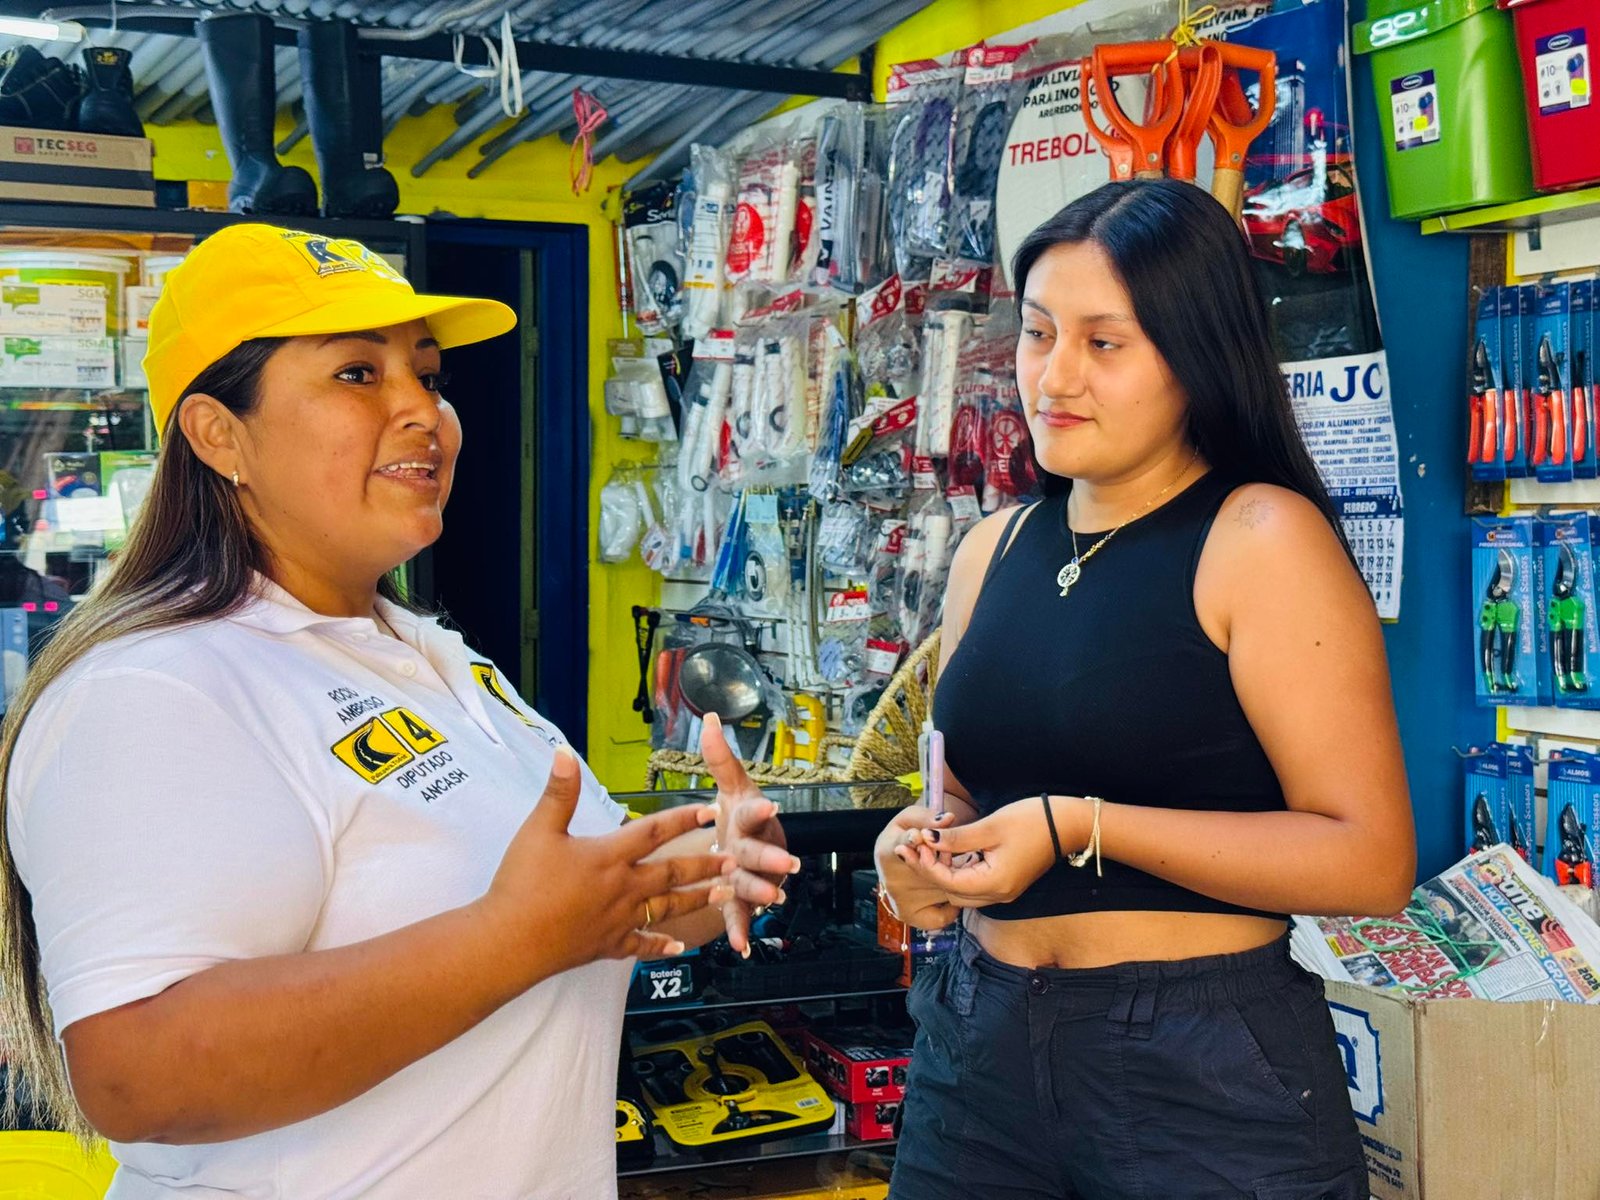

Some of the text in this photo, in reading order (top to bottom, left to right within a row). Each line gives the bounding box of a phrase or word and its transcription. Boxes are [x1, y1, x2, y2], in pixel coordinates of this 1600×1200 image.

[1023, 90, 1052, 108] PARA
[37, 138, 98, 153] TECSEG
[1009, 132, 1096, 166] TREBOL
[820, 150, 837, 231] VAINSA
[1284, 362, 1383, 402] RIA JC
[1327, 417, 1364, 428] ALUMINIO
[1344, 502, 1378, 513] FEBRERO
[1359, 521, 1364, 531] 4
[1367, 520, 1373, 531] 5
[1377, 520, 1383, 531] 6
[1389, 520, 1395, 531] 7
[1367, 538, 1374, 549] 12
[1376, 538, 1384, 549] 13
[1387, 538, 1395, 549] 14
[1367, 556, 1374, 567] 19
[1537, 555, 1545, 593] Scissors
[1582, 551, 1591, 591] Scissors
[1376, 572, 1383, 583] 27
[1385, 572, 1392, 583] 28
[1520, 555, 1531, 654] Multi-Purpose Scissors
[397, 710, 438, 743] 4
[396, 750, 453, 790] DIPUTADO
[1566, 769, 1591, 778] ALMOS
[420, 768, 469, 803] ANCASH
[1591, 793, 1600, 831] Scissors
[1482, 885, 1507, 911] HOY
[1501, 904, 1550, 960] CUPONES
[650, 968, 682, 979] Bateria
[650, 977, 681, 1000] X2
